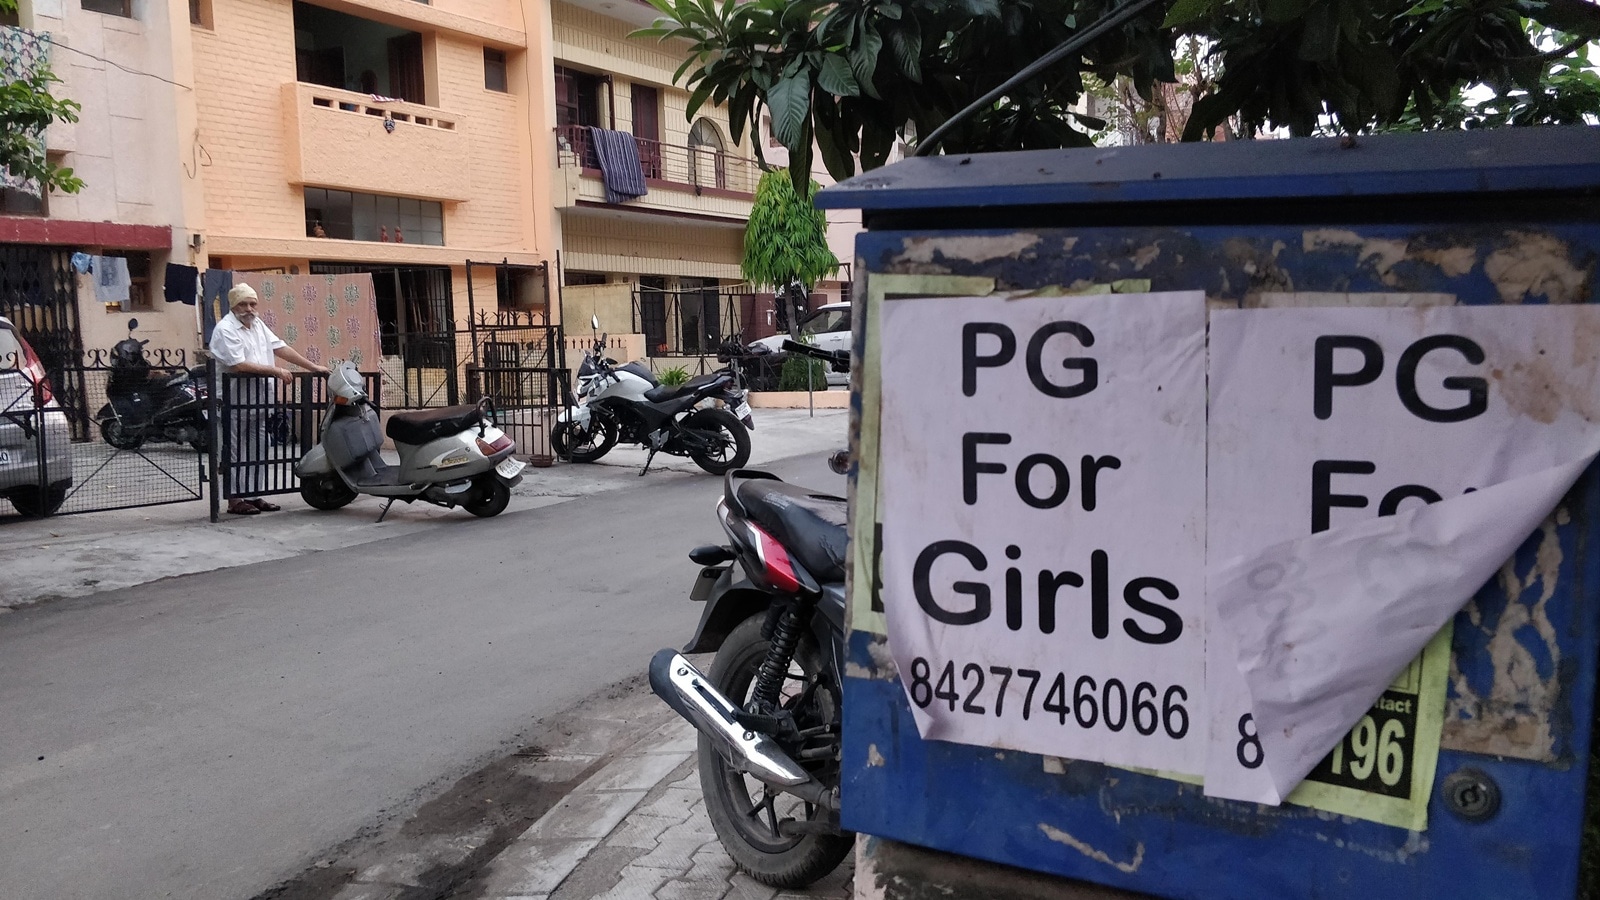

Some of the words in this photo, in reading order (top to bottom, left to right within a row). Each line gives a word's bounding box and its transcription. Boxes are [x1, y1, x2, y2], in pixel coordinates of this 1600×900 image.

[962, 320, 1098, 398] PG
[1313, 334, 1489, 423] PG
[962, 432, 1121, 511] For
[912, 540, 1183, 644] Girls
[911, 656, 1189, 739] 8427746066
[1375, 695, 1412, 714] tact
